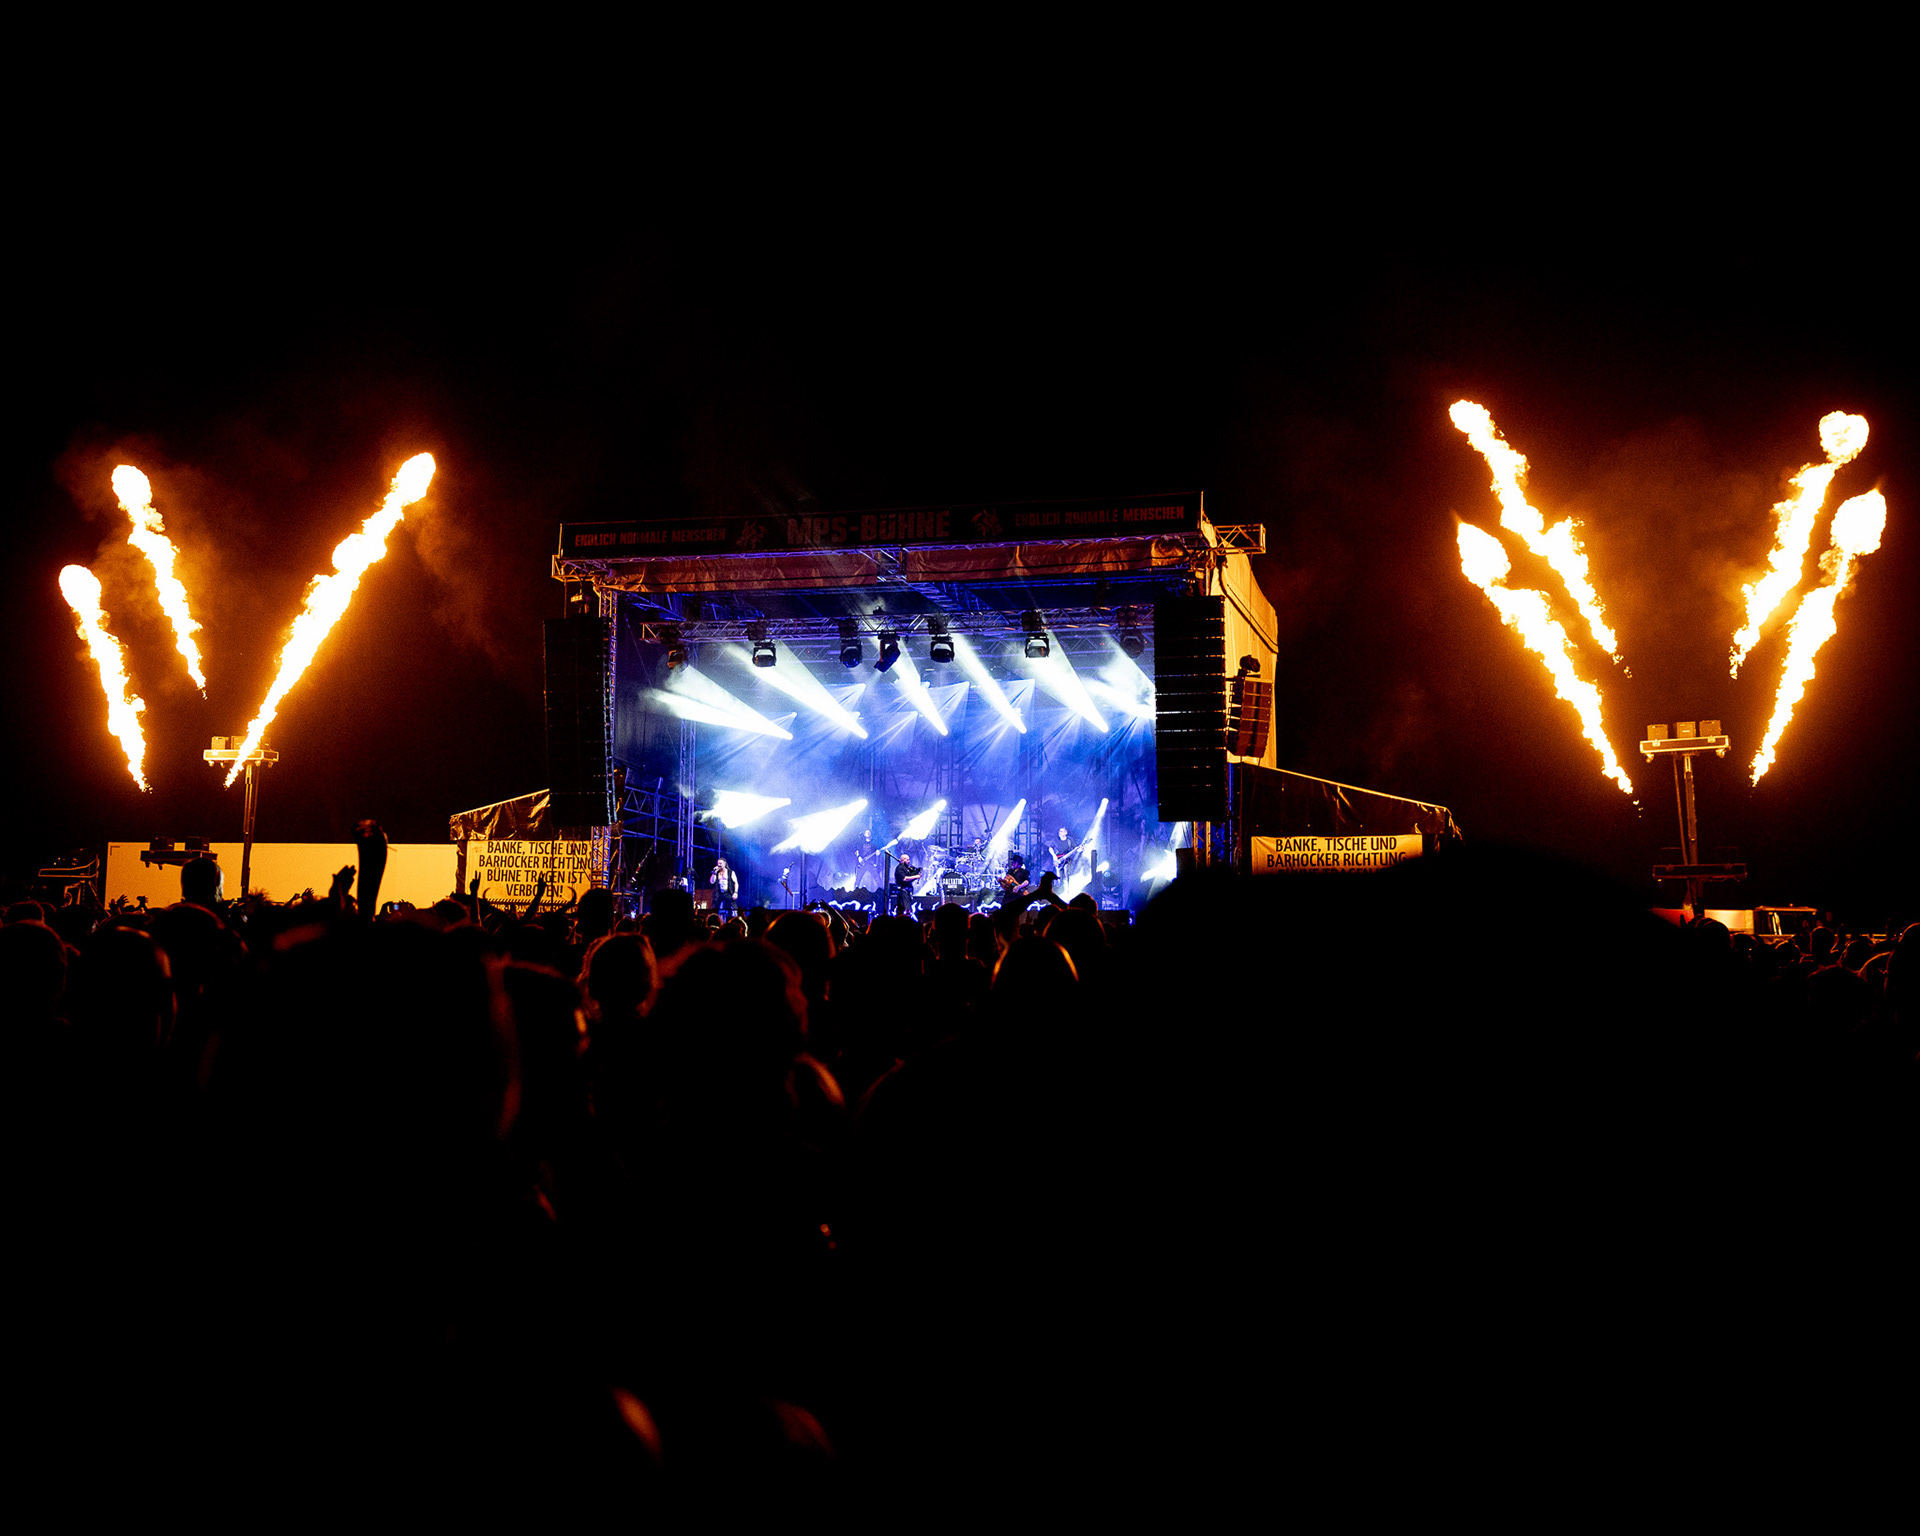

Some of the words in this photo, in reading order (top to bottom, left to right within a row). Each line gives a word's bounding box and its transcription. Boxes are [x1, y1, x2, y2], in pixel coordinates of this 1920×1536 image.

[1122, 505, 1185, 523] MENSCHEN
[671, 527, 727, 543] MENSCHEN
[786, 510, 951, 545] MPS-BÜHNE
[529, 841, 563, 855] TISCHE
[566, 842, 588, 855] UND
[1275, 836, 1322, 852] BÄNKE,
[1325, 837, 1367, 851] TISCHE
[1371, 837, 1397, 850] UND
[479, 855, 540, 869] BARHOCKER
[1267, 853, 1339, 868] BARHOCKER
[487, 867, 522, 882] BÜHNE
[568, 871, 584, 884] IST
[506, 883, 564, 898] VERBOEN!
